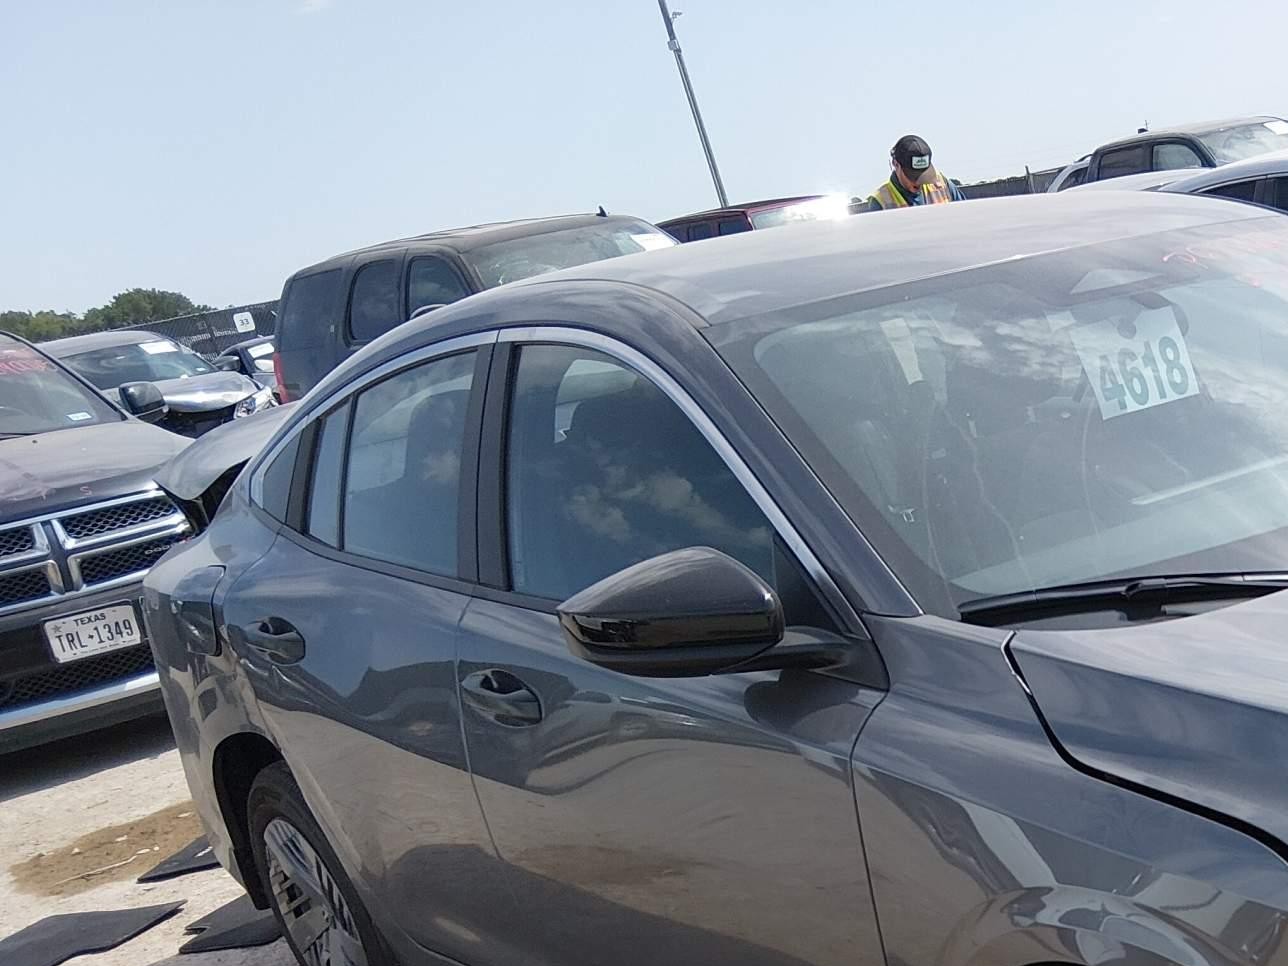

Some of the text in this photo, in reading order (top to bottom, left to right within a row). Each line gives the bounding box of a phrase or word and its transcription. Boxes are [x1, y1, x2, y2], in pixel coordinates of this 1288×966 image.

[239, 318, 250, 326] 33
[1099, 335, 1189, 410] 4618
[73, 612, 106, 627] TEXAS
[55, 630, 88, 653] TRL
[93, 618, 134, 644] 1349
